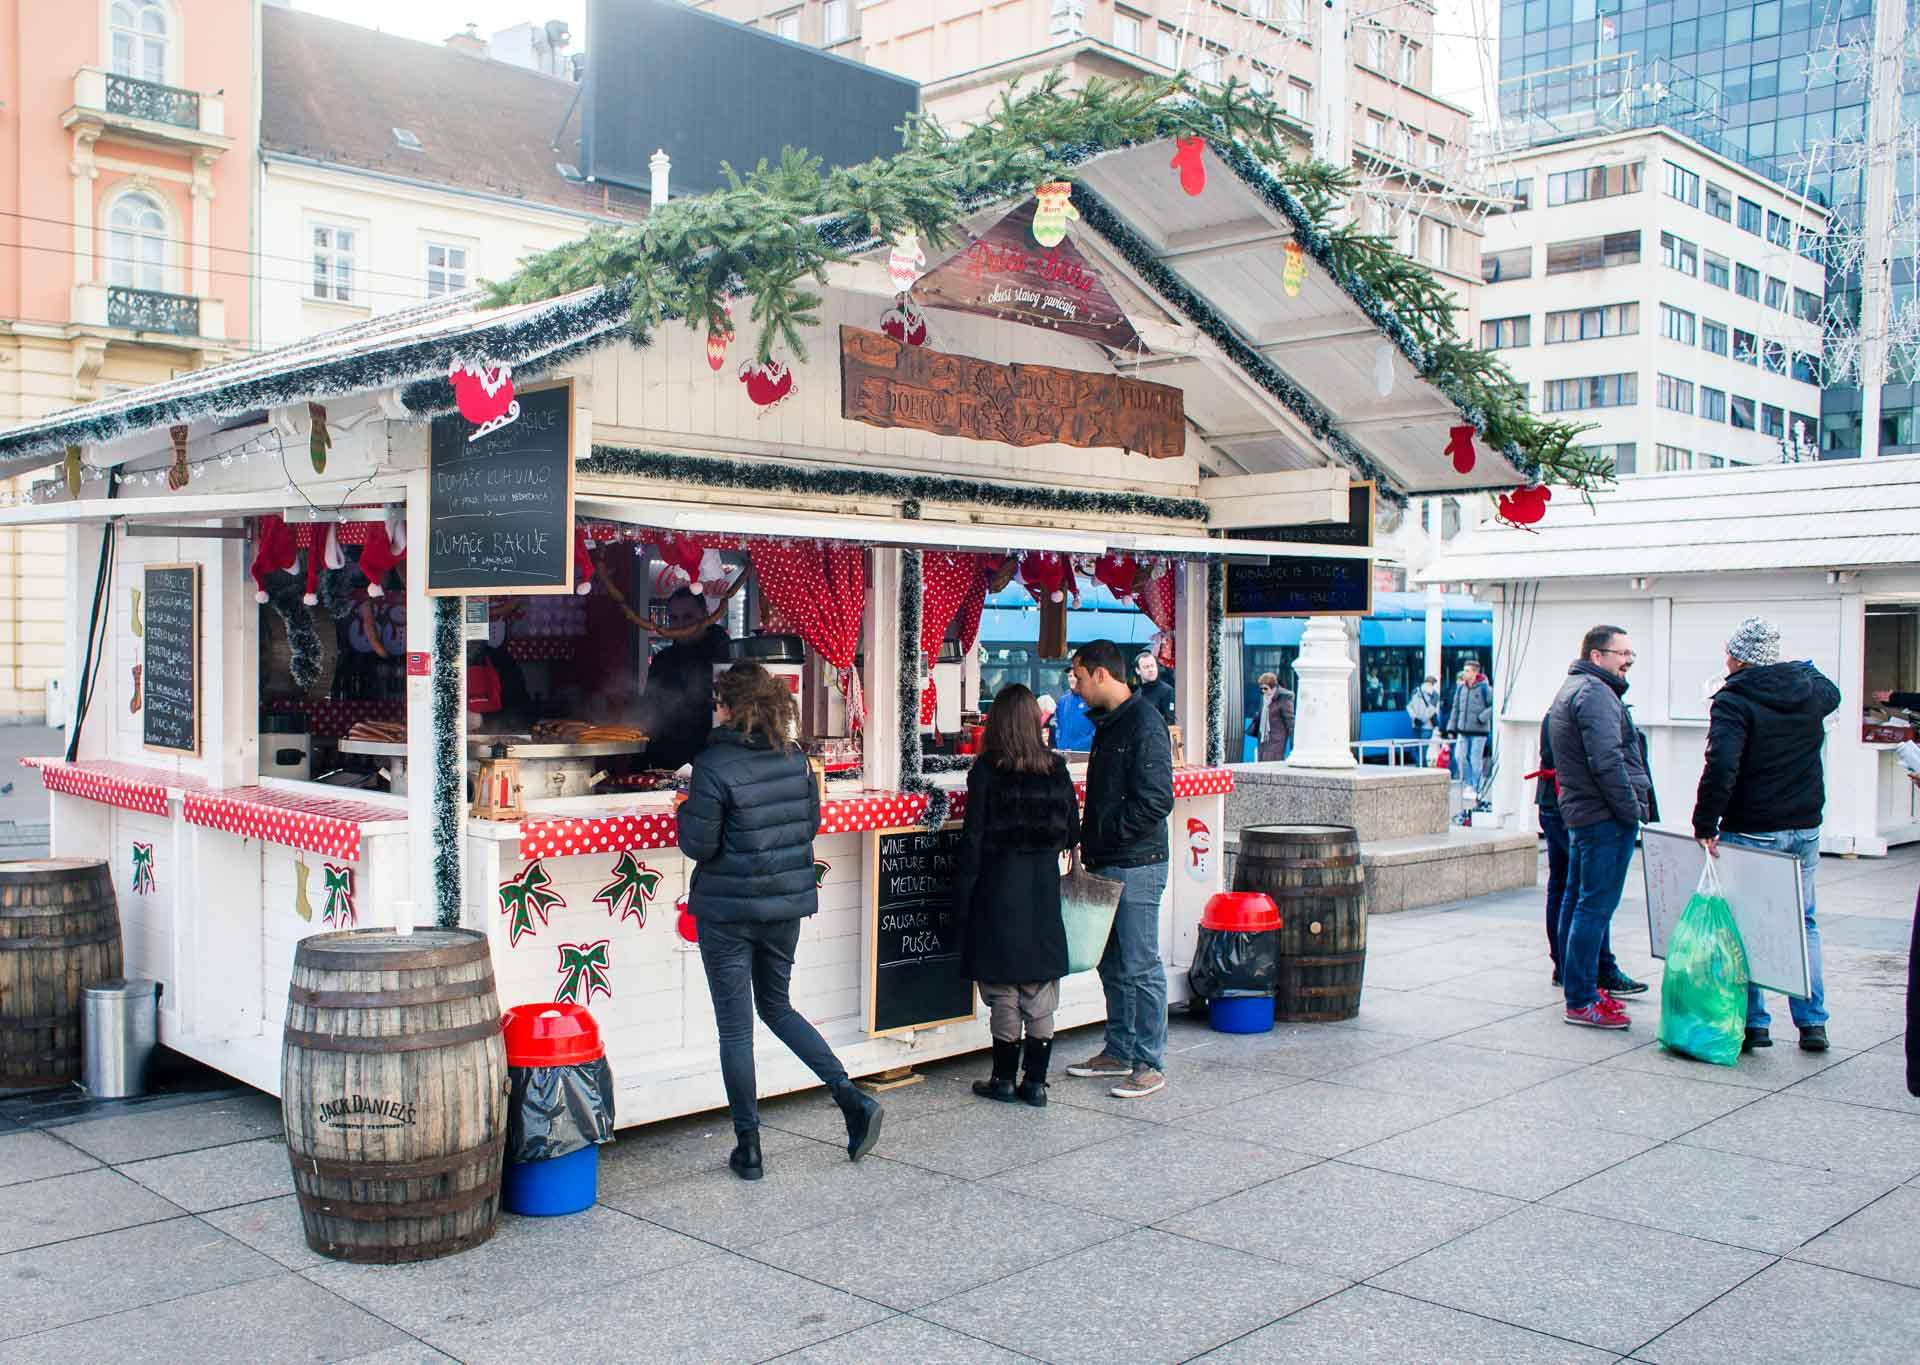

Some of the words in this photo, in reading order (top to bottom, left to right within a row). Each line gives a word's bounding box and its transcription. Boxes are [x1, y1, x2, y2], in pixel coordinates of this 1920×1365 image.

[1015, 287, 1040, 308] starog
[492, 528, 552, 555] RAKIJE
[881, 838, 907, 855] WINE
[882, 856, 928, 873] NATURE
[881, 912, 929, 931] SAUSAGE
[901, 930, 941, 953] PUŠČA
[320, 1098, 351, 1123] JACK
